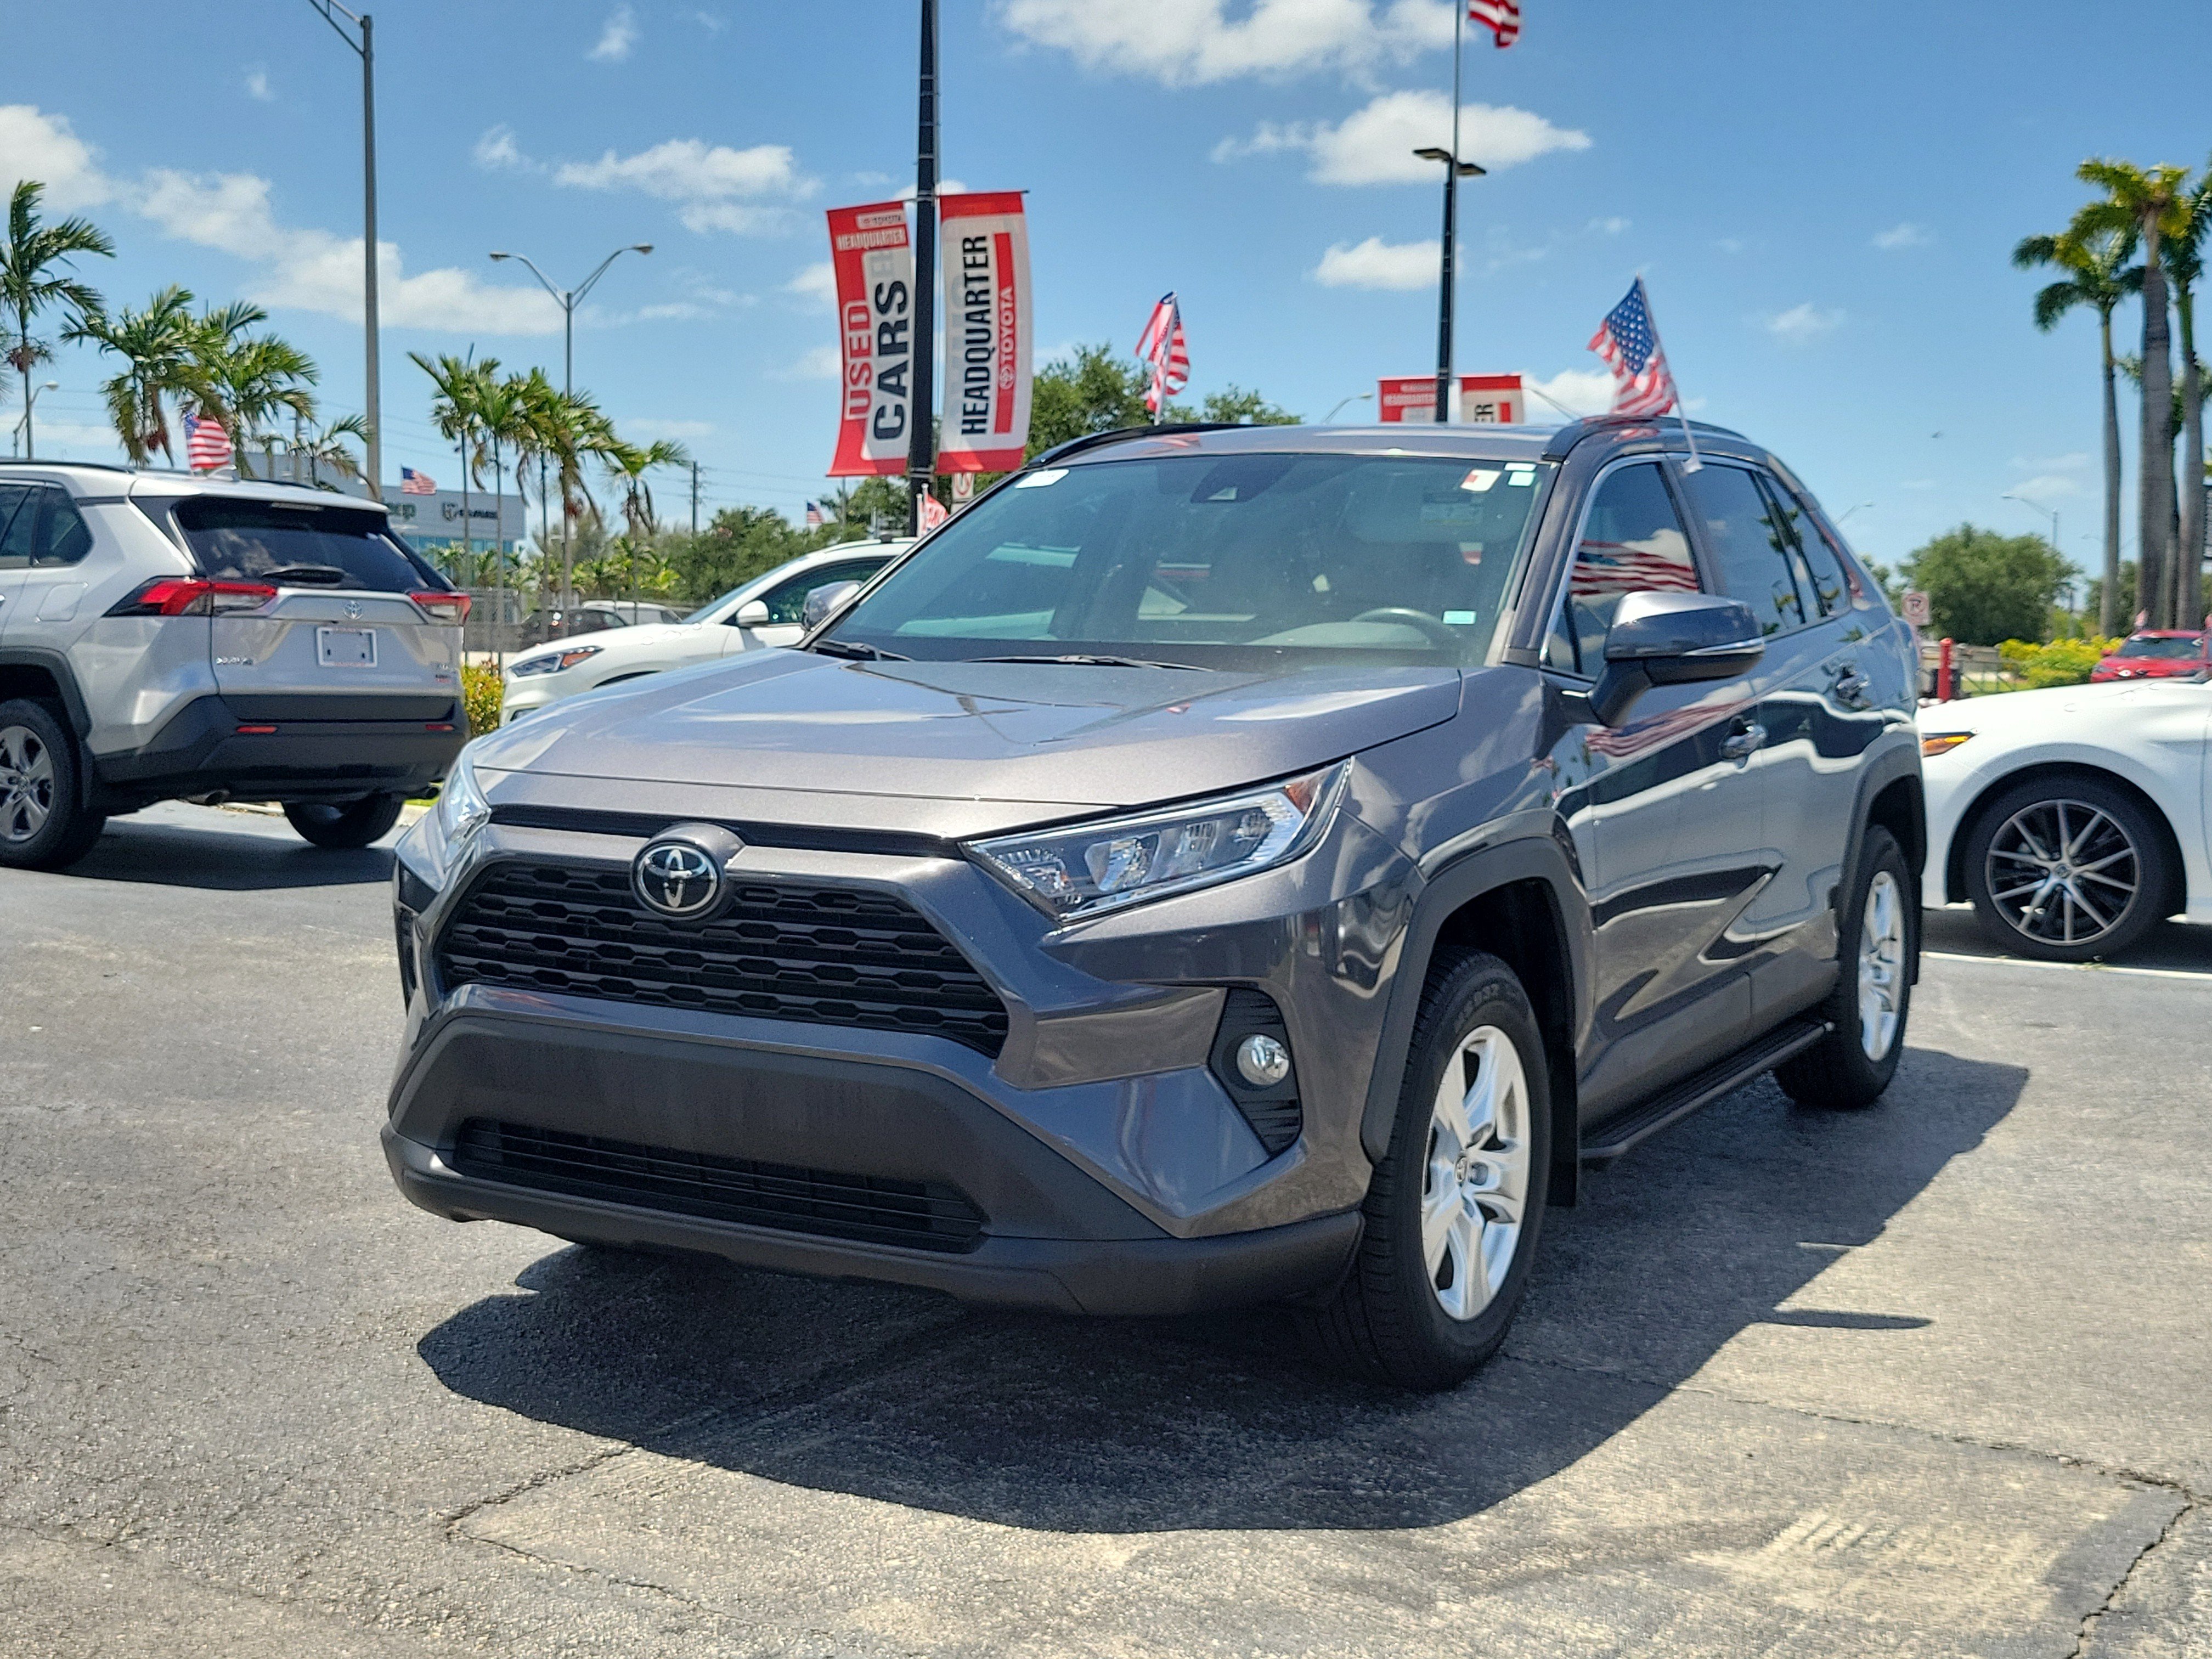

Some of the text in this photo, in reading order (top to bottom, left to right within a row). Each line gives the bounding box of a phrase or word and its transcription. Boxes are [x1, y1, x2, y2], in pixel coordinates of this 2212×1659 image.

[848, 303, 872, 419] USED
[874, 280, 909, 440] CARS
[961, 235, 995, 435] HEADQUARTER
[998, 286, 1015, 364] TOYOTA
